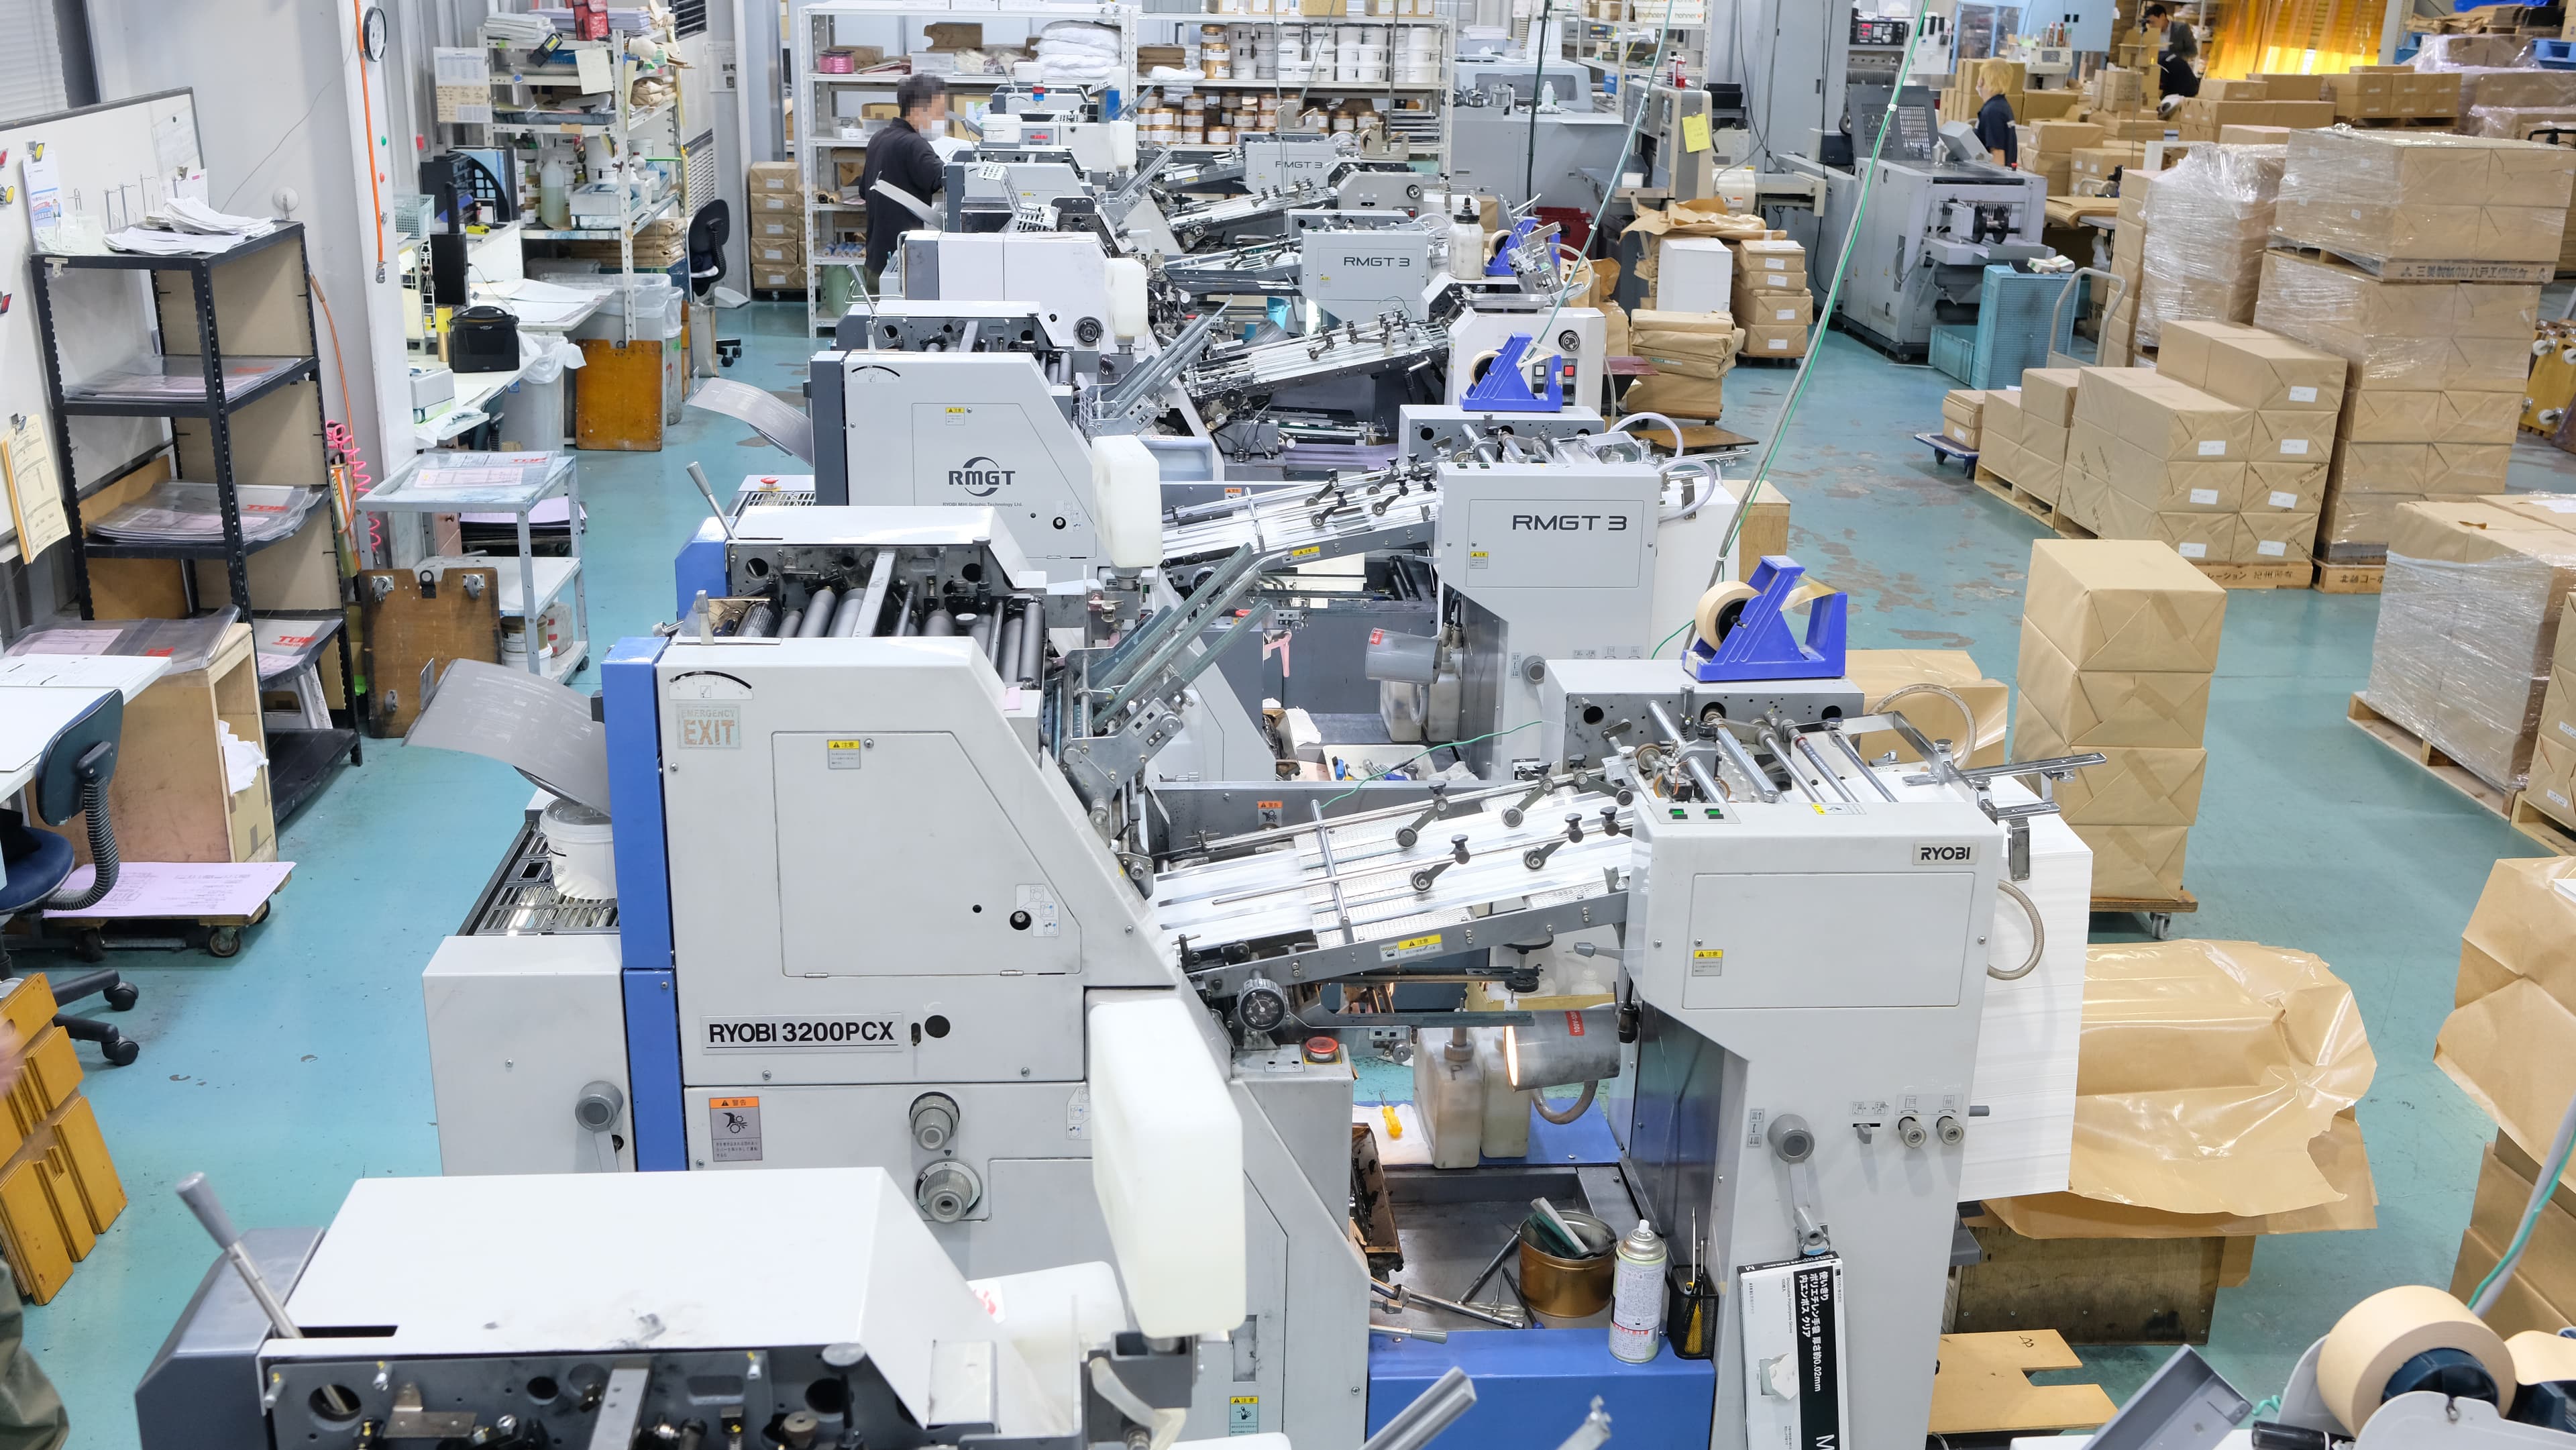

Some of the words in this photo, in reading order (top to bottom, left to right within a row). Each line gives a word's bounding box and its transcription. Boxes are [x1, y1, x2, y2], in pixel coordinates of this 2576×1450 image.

[1275, 160, 1312, 168] RMGT
[1344, 256, 1395, 267] RMGT
[1399, 257, 1410, 267] 3
[949, 470, 1016, 485] RMGT
[1512, 515, 1601, 531] RMGT
[1607, 515, 1627, 531] 3
[681, 709, 735, 719] EMERGENCY
[684, 719, 735, 745] EXIT
[1920, 846, 1971, 860] RYOBI
[709, 1023, 777, 1043] RYOBI
[782, 1021, 894, 1042] 3200PCX
[1799, 1274, 1810, 1314] 内エンボス
[1819, 1271, 1829, 1301] 使いきり
[1809, 1273, 1821, 1334] ポリエチレン手袋
[1801, 1316, 1811, 1338] クリア
[1812, 1337, 1822, 1392] 厚さ約0.02mm
